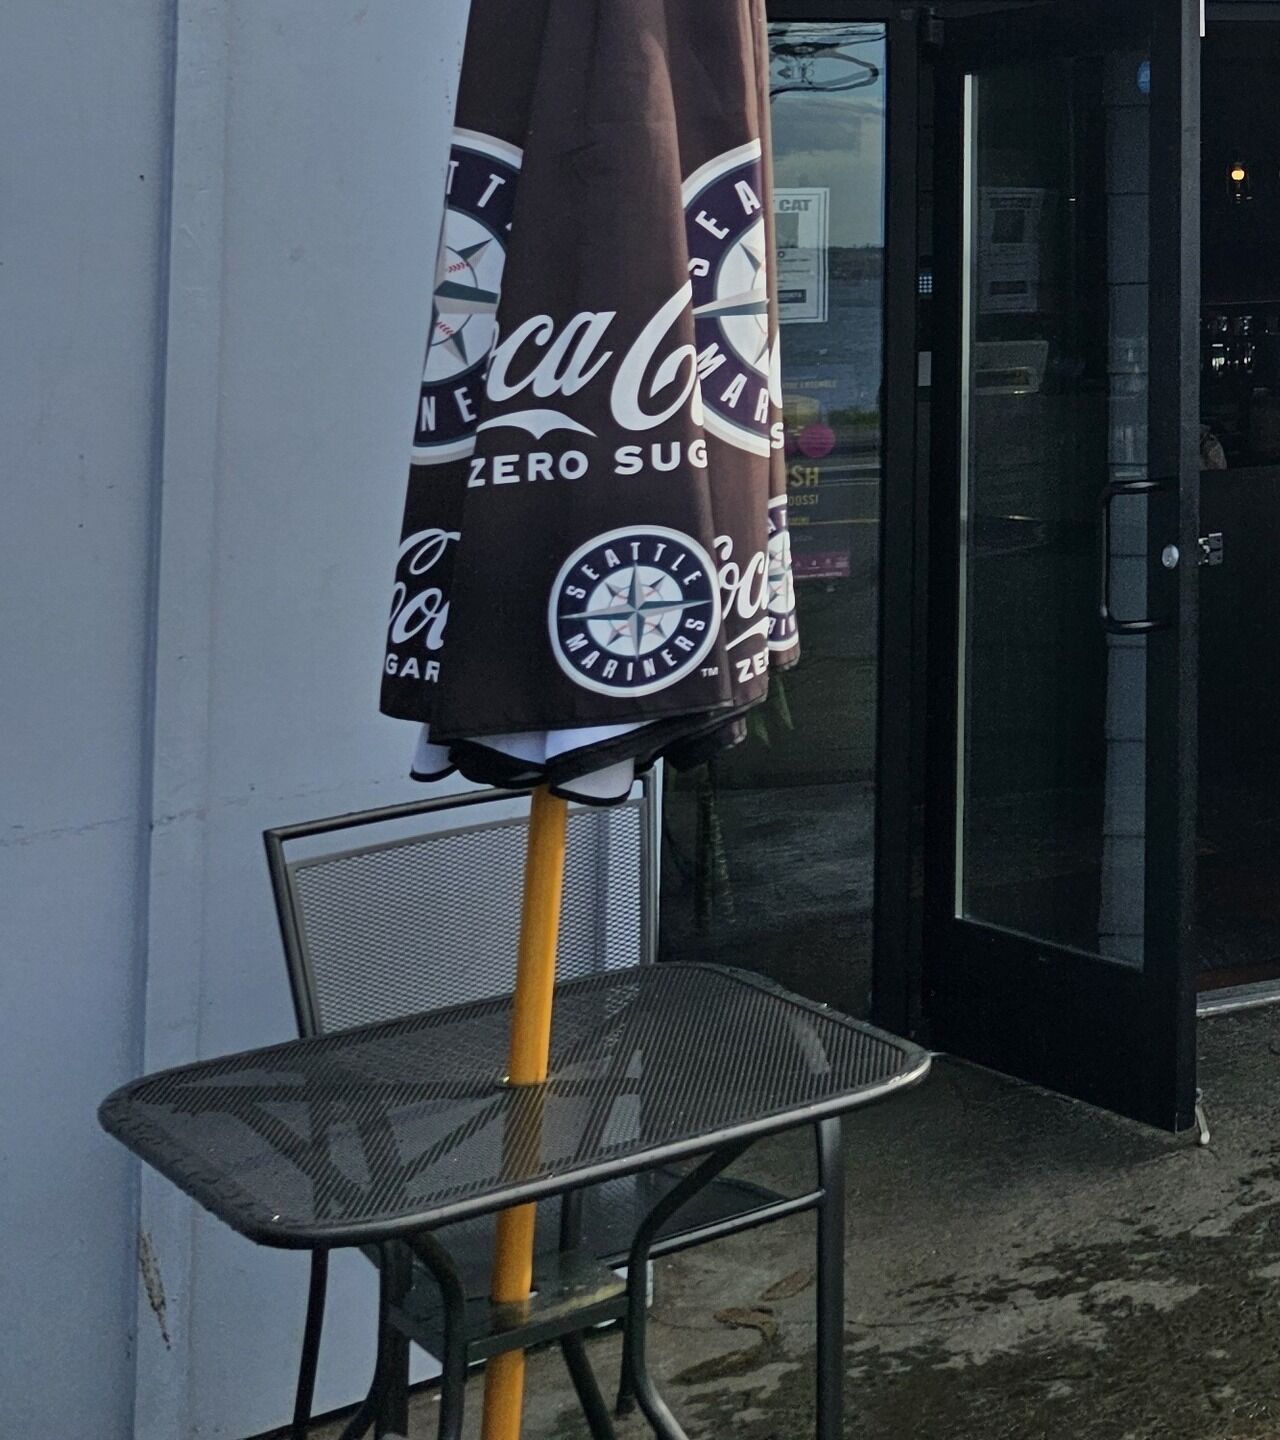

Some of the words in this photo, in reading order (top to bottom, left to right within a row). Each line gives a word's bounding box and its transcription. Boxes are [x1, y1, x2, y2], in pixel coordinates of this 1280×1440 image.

[779, 199, 812, 211] CAT
[466, 449, 589, 488] ZERO
[613, 439, 708, 475] SUG
[565, 542, 702, 599] SEATTLE
[385, 653, 441, 684] GAR
[565, 618, 706, 682] MARINERS
